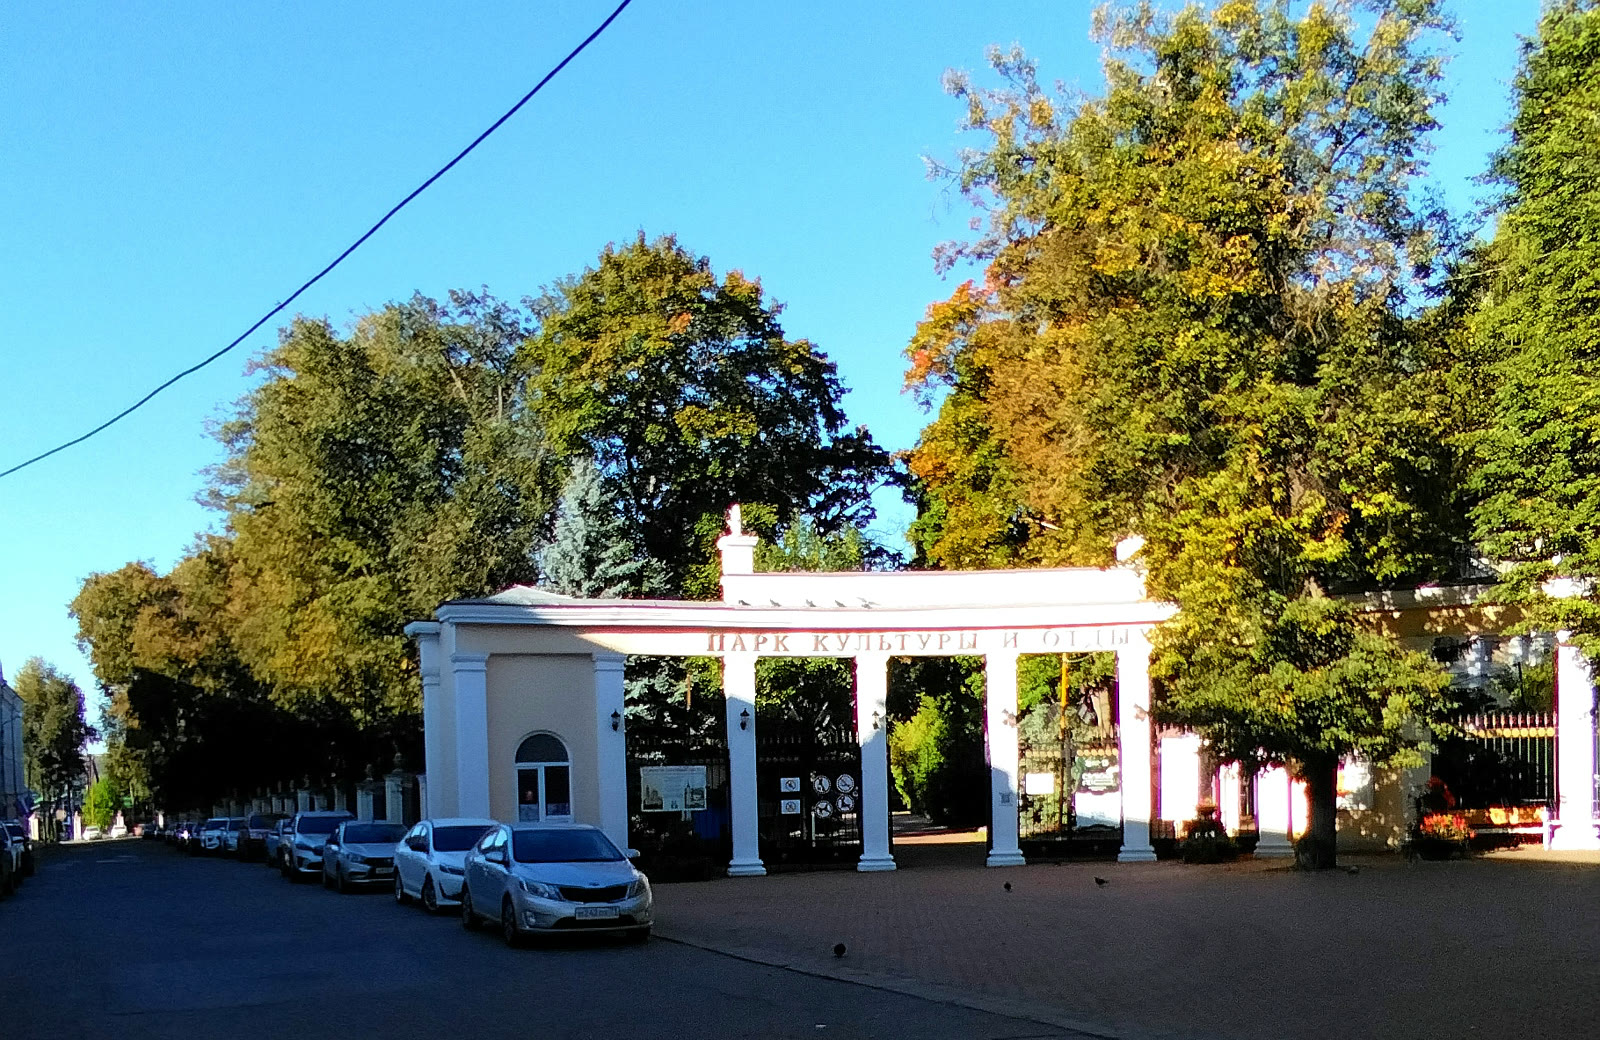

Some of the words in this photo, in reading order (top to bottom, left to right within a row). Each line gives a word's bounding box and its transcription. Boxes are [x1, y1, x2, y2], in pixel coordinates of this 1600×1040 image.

[706, 633, 790, 652] ПАРК
[812, 632, 978, 651] КУЛЬТУРЫ
[1003, 631, 1019, 649] И
